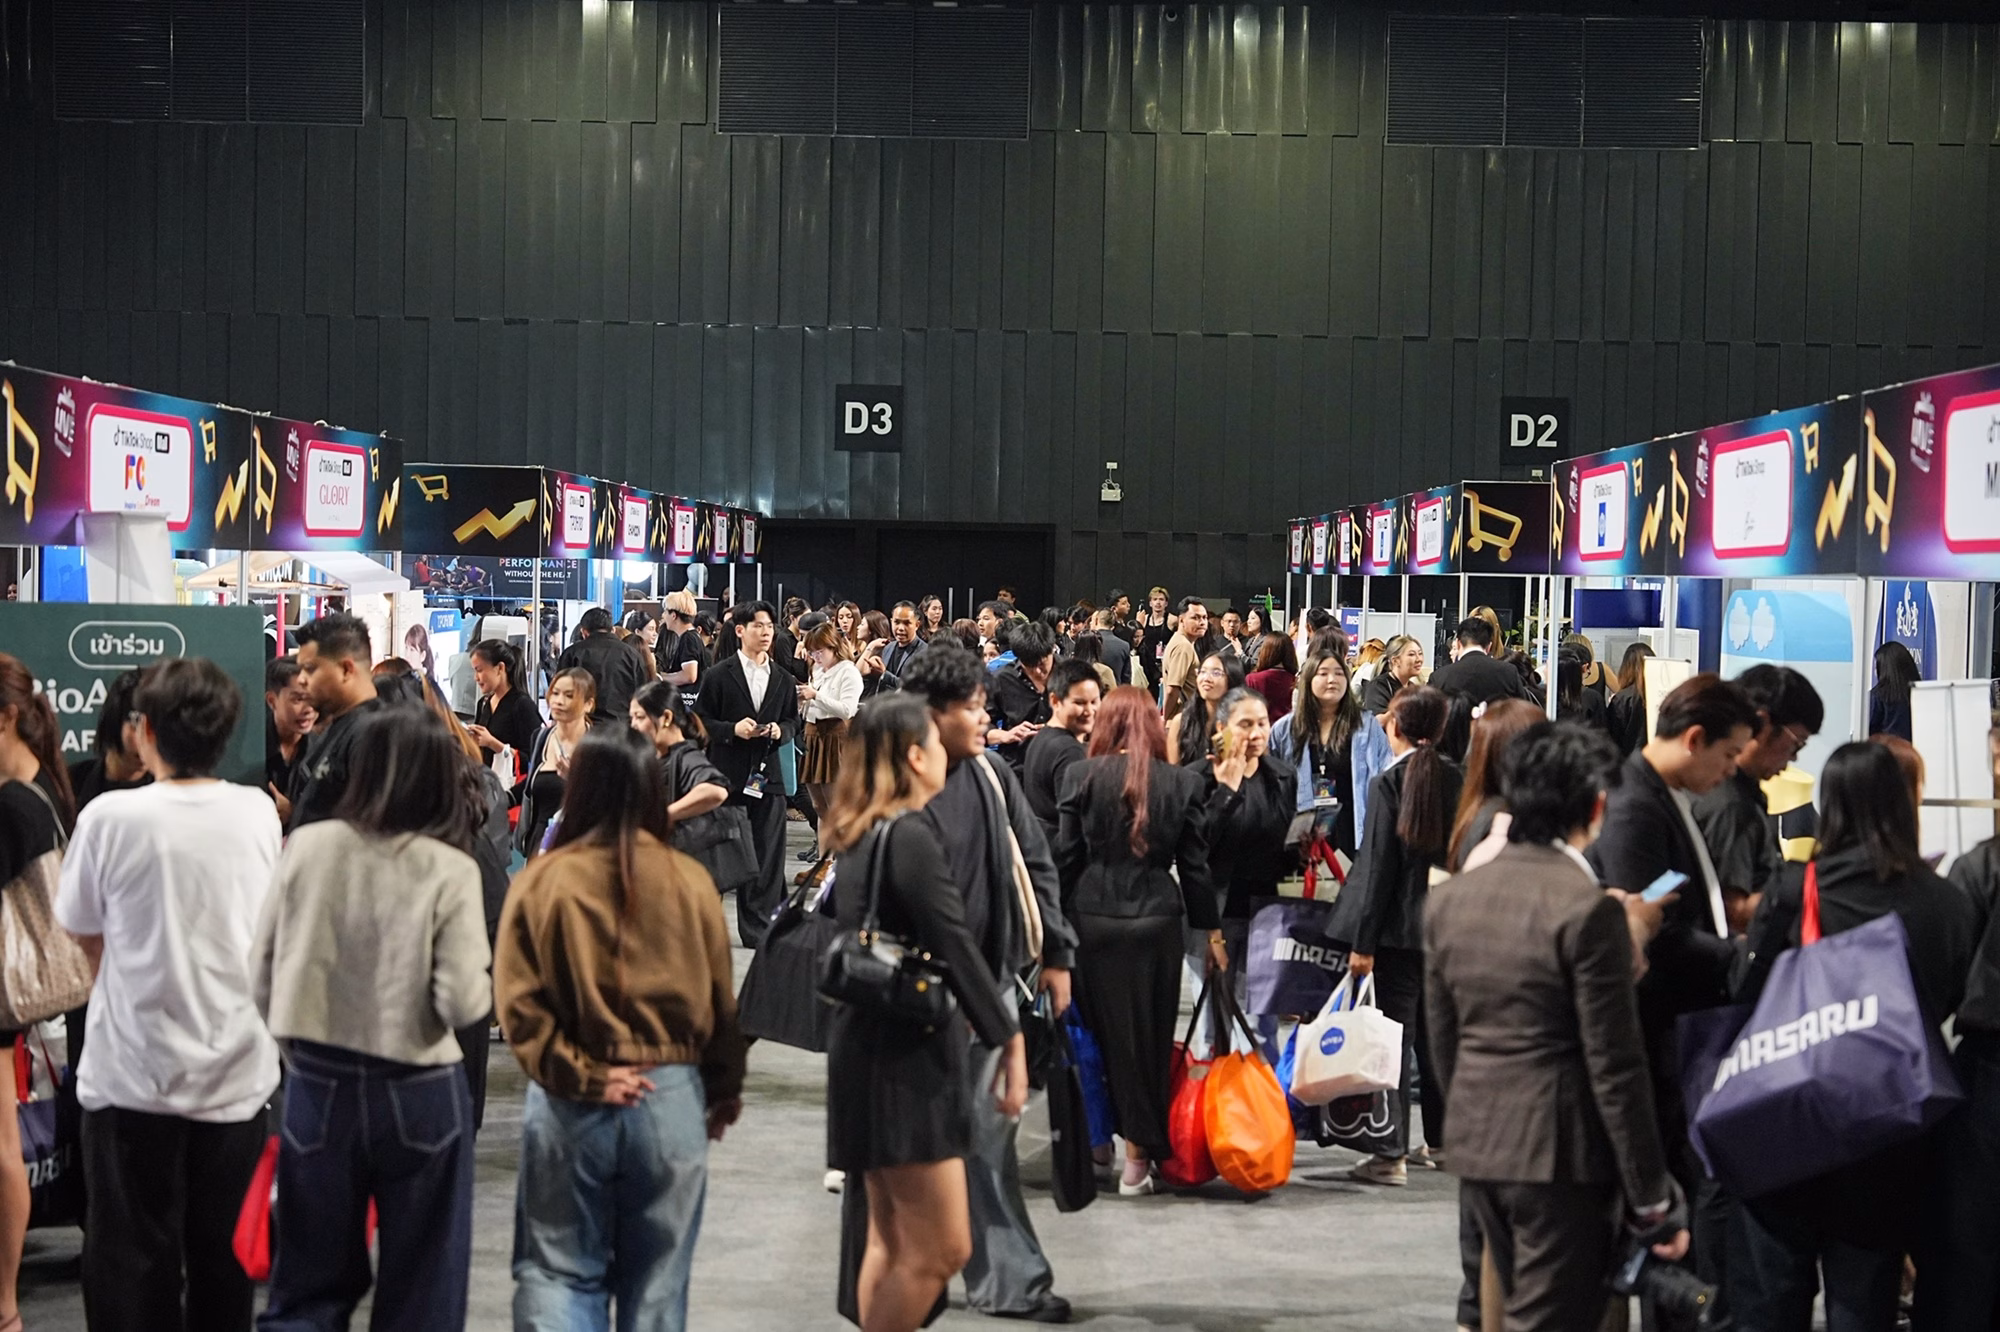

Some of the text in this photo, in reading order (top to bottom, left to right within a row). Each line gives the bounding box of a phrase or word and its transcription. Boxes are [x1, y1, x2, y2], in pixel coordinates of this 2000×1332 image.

[844, 401, 893, 435] D3
[121, 430, 139, 448] TikTok
[140, 432, 153, 453] Shop
[1510, 413, 1558, 448] D2
[319, 484, 350, 506] GLORY
[504, 570, 534, 578] WITHOU
[90, 633, 164, 655] เข้าร่วม
[33, 678, 108, 713] ioA
[61, 730, 97, 752] AF
[1321, 1036, 1342, 1047] NIVEA
[1712, 995, 1879, 1092] MASARU
